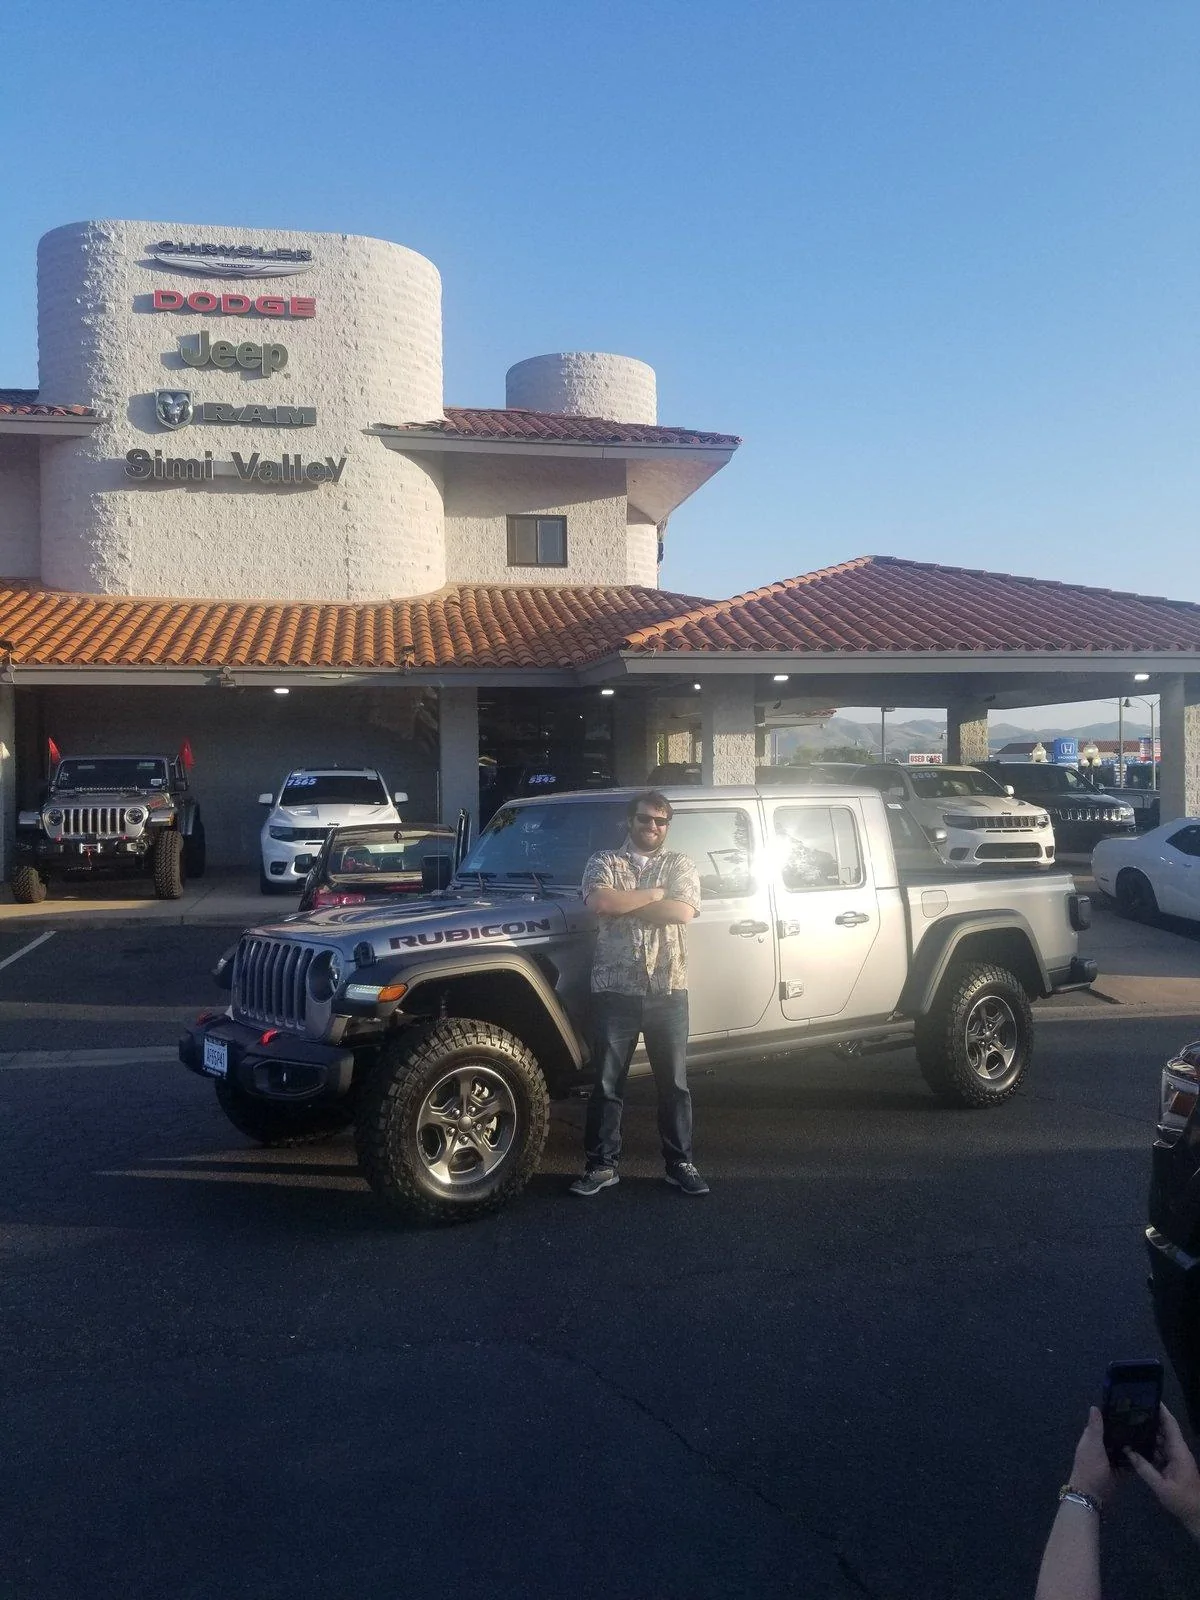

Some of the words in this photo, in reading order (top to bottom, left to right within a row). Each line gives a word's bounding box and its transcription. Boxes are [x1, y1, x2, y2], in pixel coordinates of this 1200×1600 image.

[157, 240, 313, 261] CHRYSLER
[153, 289, 316, 318] DODGE
[180, 330, 289, 378] Jeep
[202, 402, 317, 427] RAM
[124, 448, 214, 480] Simi
[231, 451, 348, 483] Valley
[910, 755, 925, 763] USED
[388, 918, 550, 950] RUBICON
